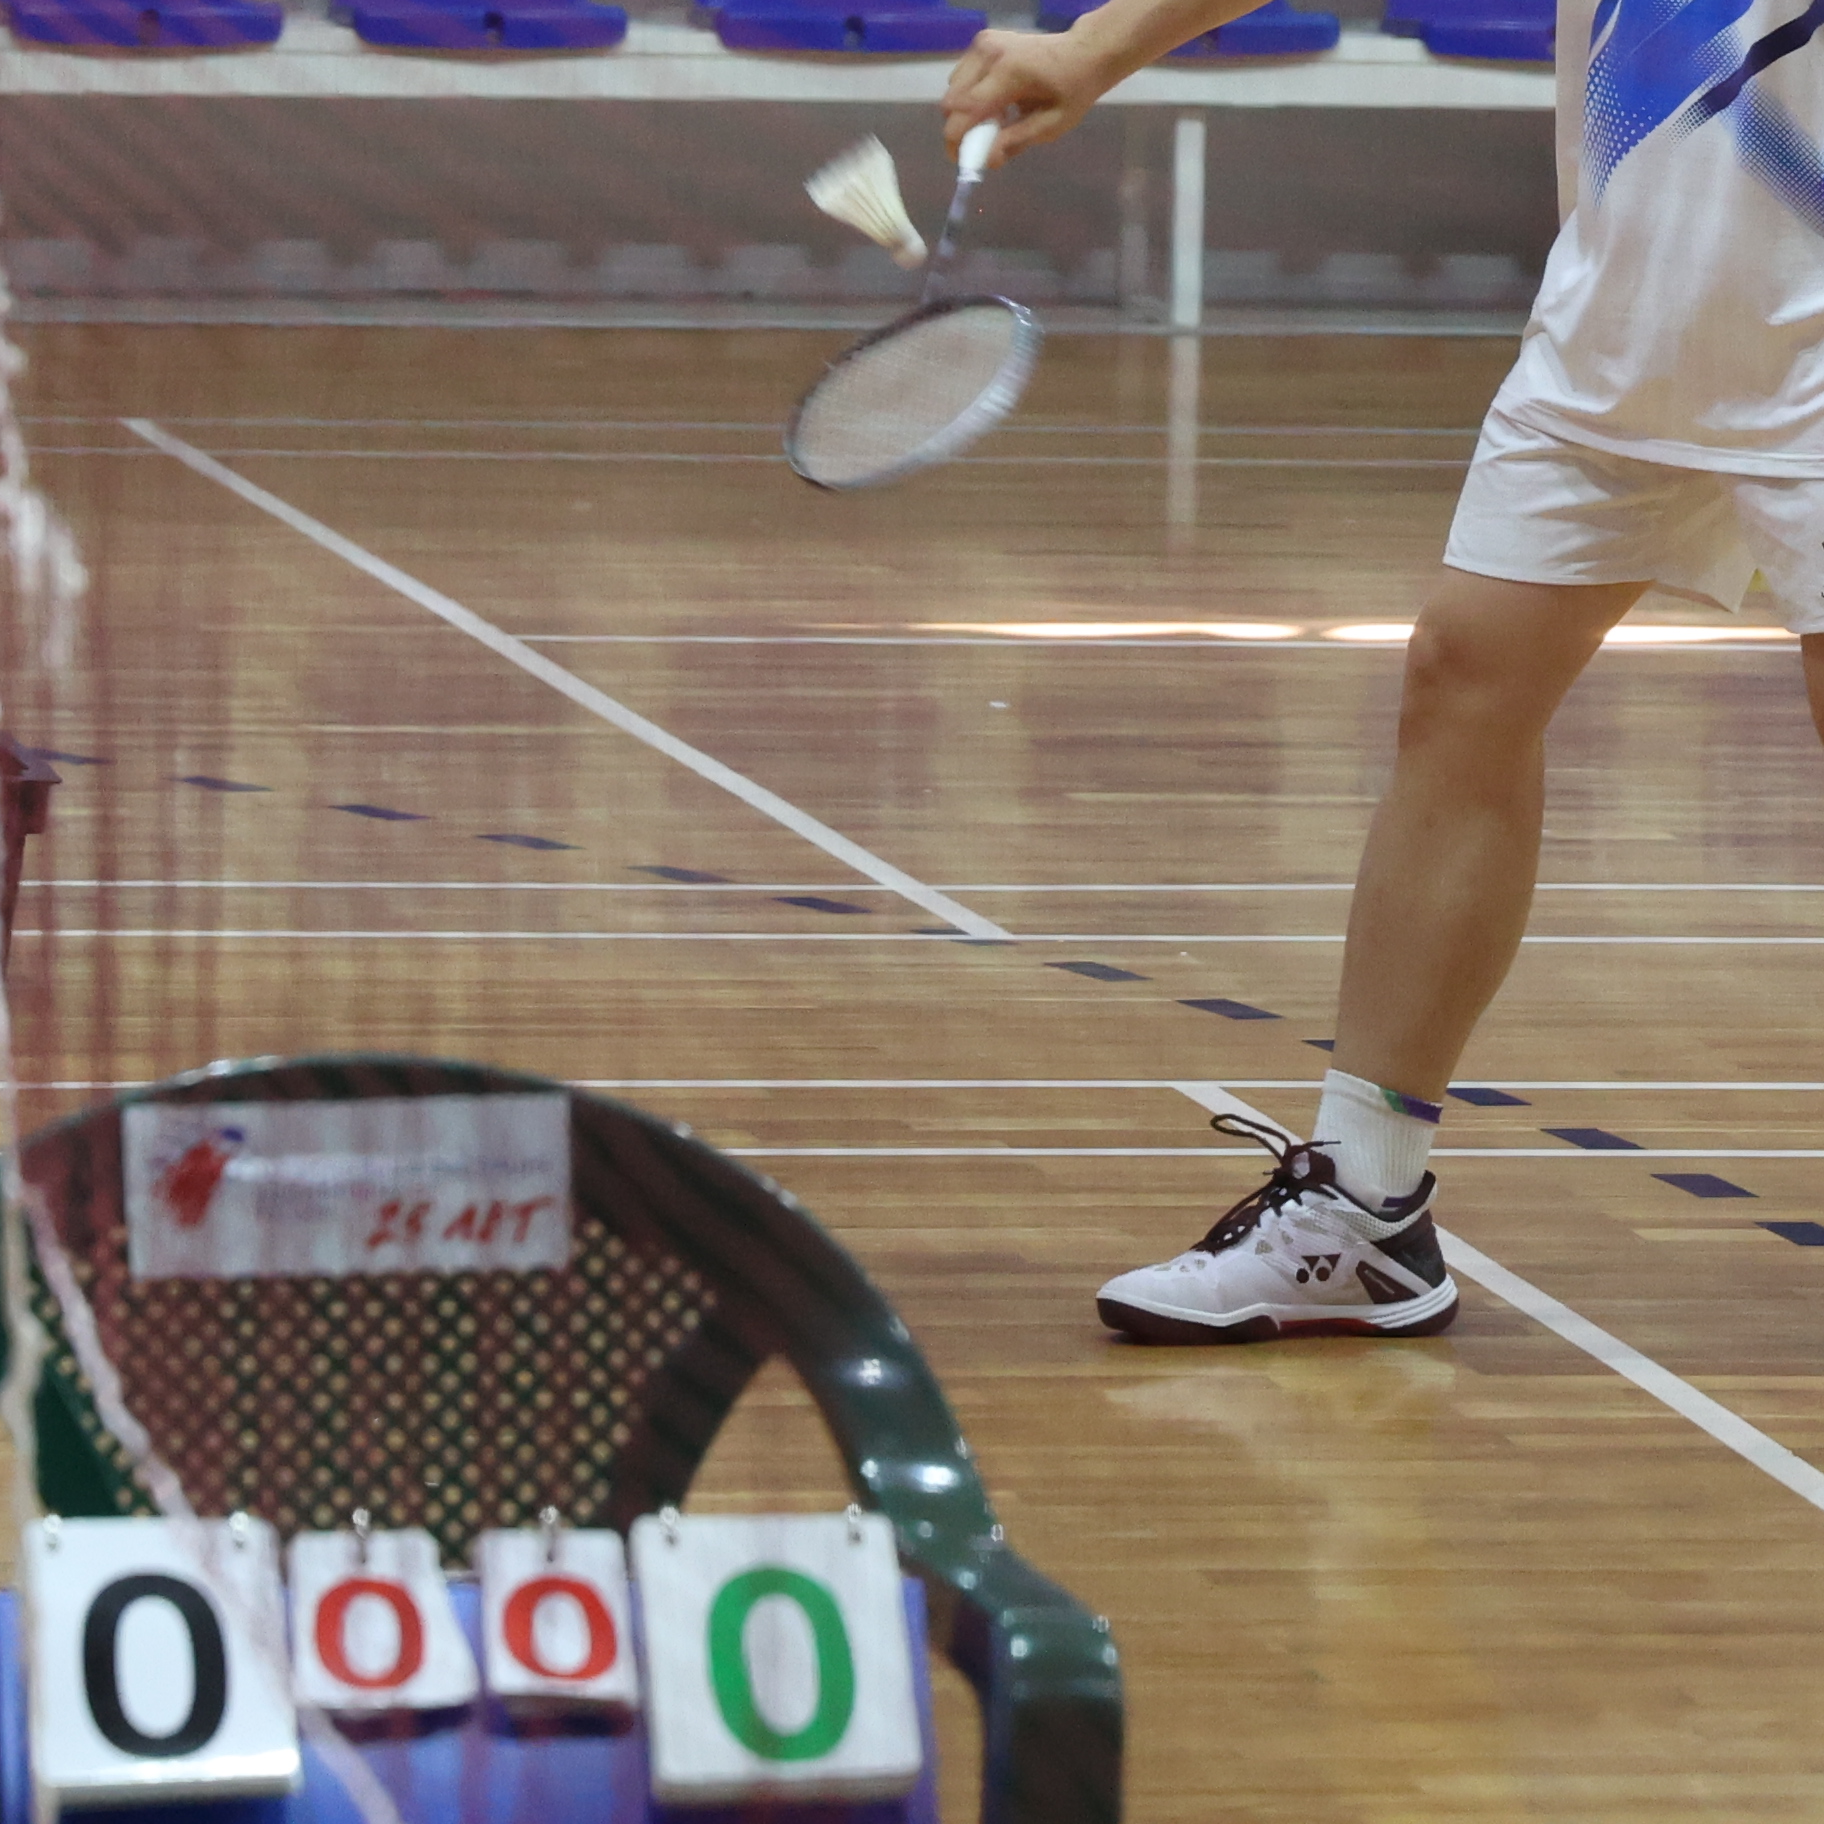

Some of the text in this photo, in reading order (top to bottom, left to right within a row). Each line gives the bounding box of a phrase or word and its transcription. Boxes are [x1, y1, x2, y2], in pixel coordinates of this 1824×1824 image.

[82, 1565, 856, 1762] 0 0 0 0
